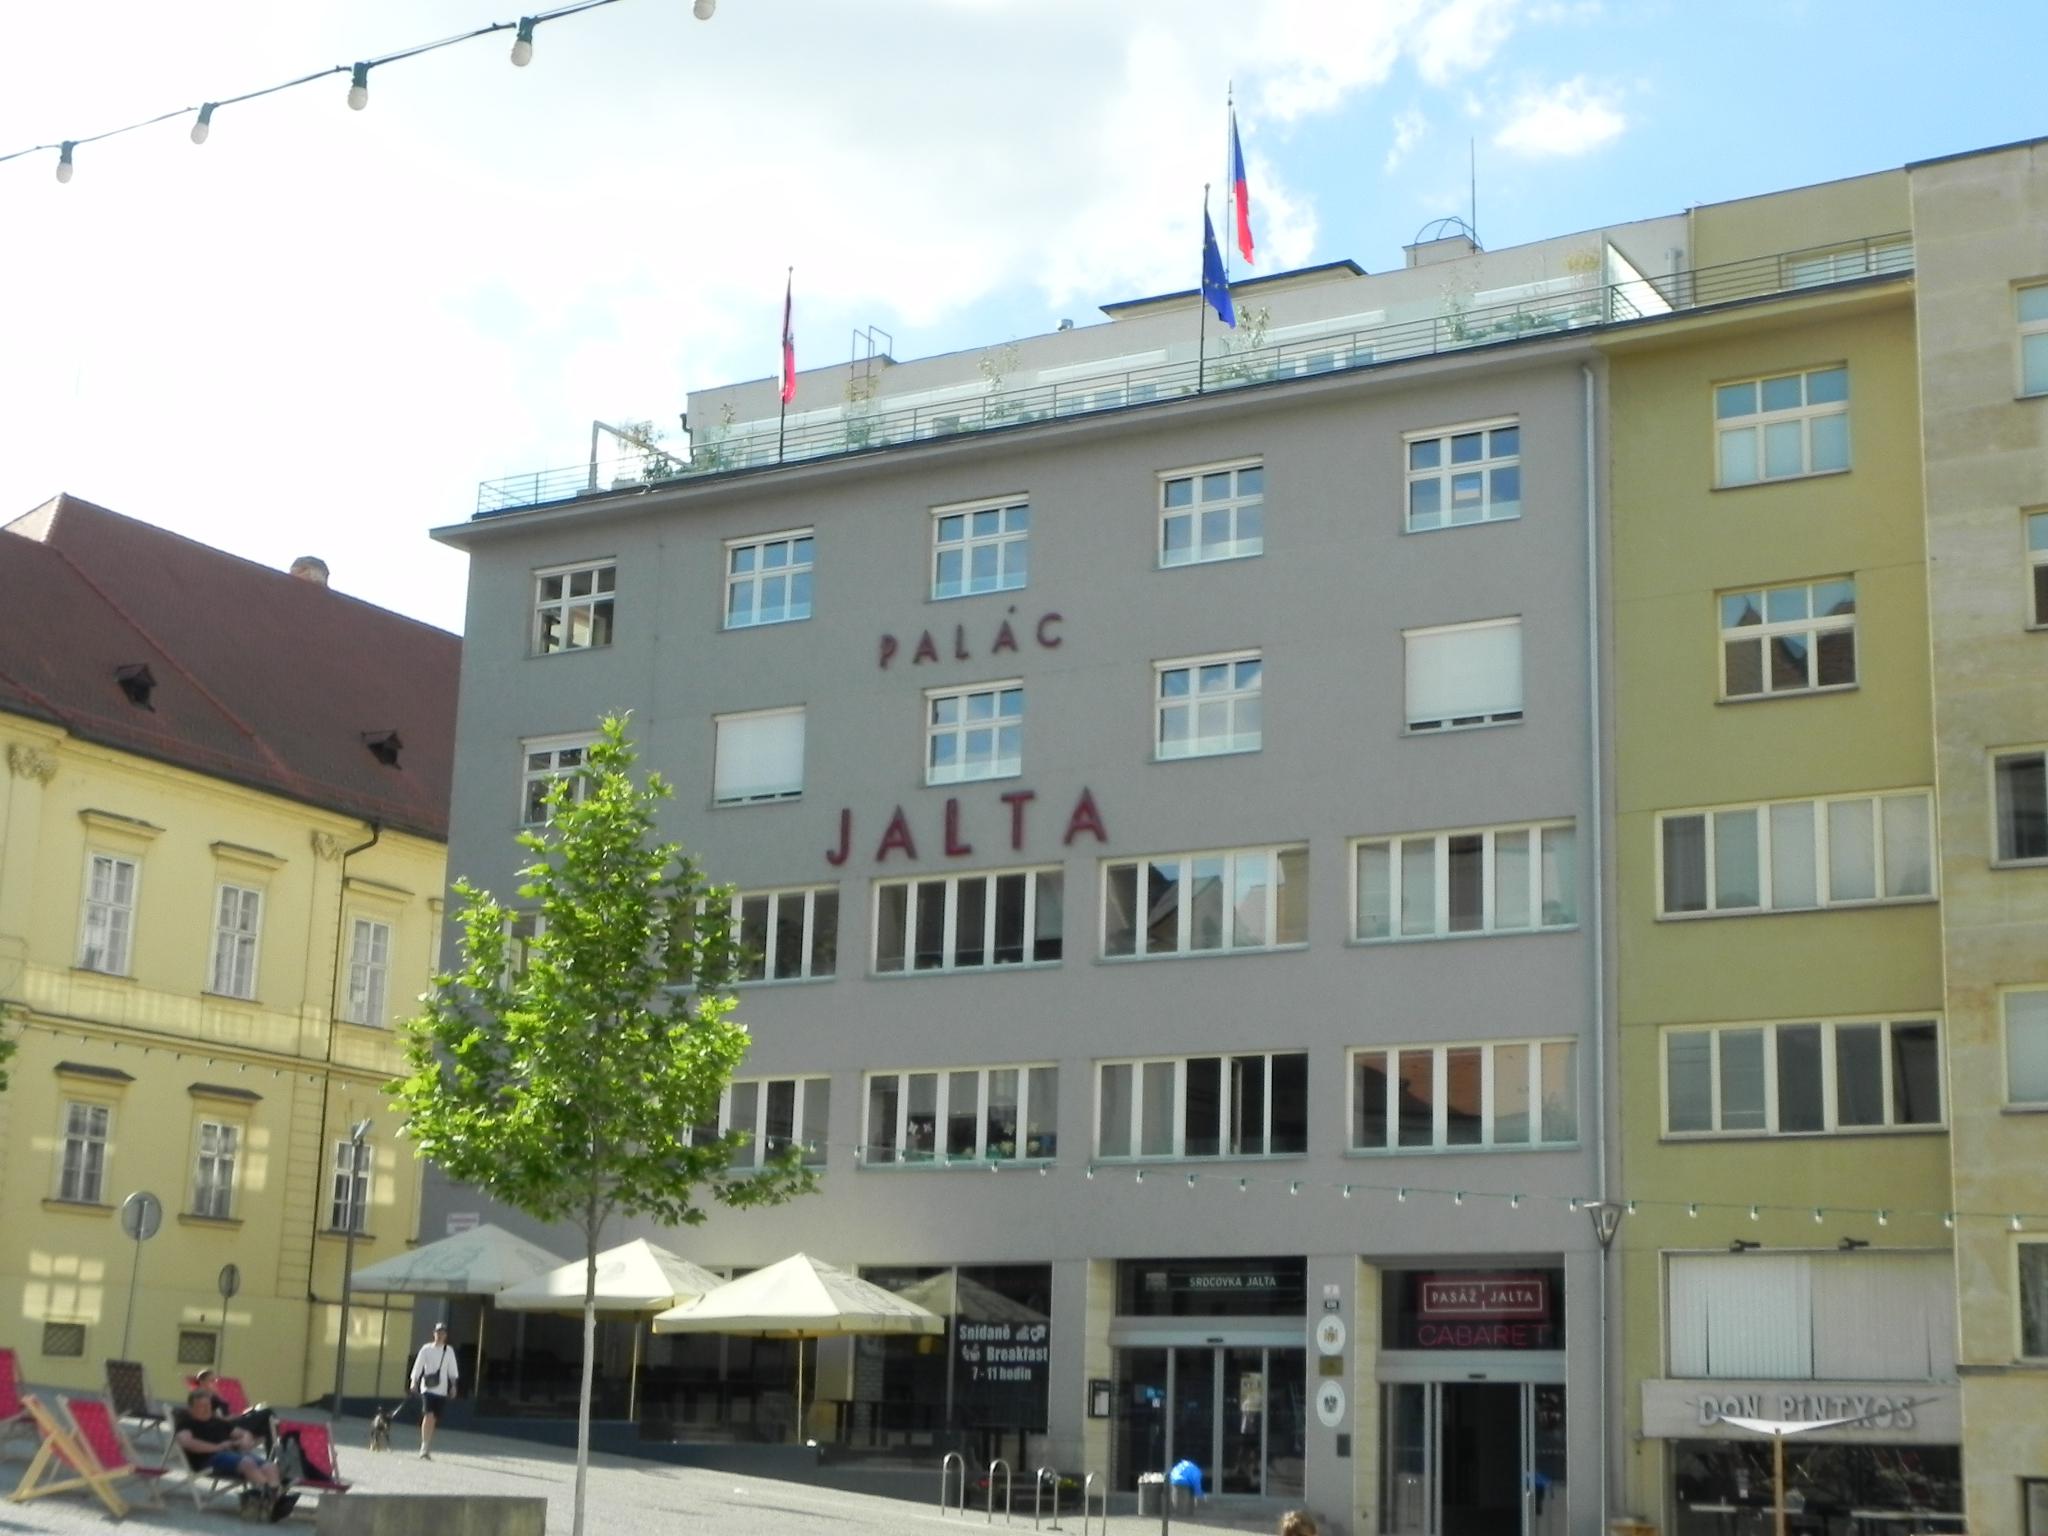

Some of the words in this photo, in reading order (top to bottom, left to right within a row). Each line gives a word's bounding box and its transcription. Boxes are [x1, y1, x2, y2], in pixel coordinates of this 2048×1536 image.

[877, 604, 1063, 669] PALÁC
[826, 786, 1108, 866] JALTA
[1189, 1277, 1242, 1288] SRDCOVKA
[1247, 1276, 1277, 1287] JALTA
[1432, 1288, 1477, 1304] PASÁŽ
[1490, 1291, 1533, 1303] JALTA
[1418, 1324, 1549, 1346] CABARET
[986, 1346, 1048, 1362] Breakfast
[972, 1366, 979, 1381] 7
[987, 1366, 998, 1381] 11
[999, 1366, 1032, 1381] hodin
[1699, 1395, 1761, 1426] DON
